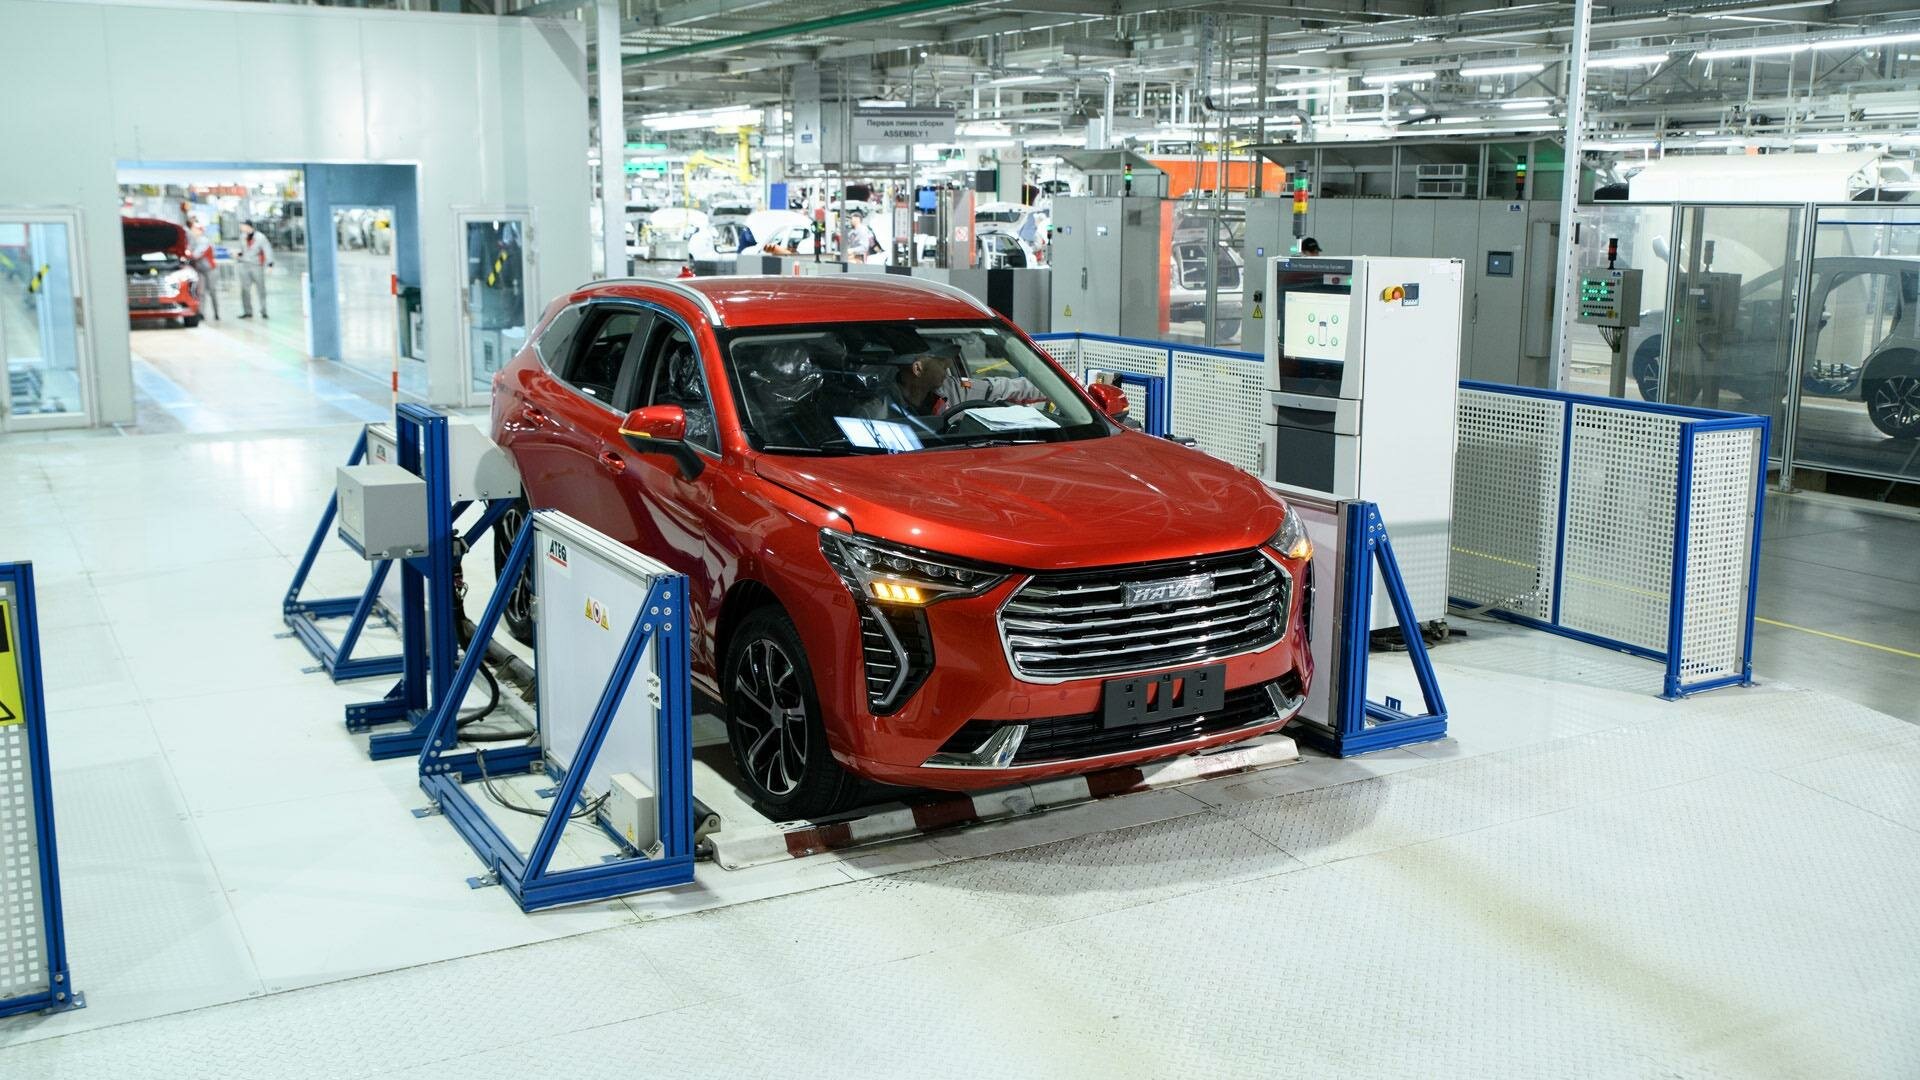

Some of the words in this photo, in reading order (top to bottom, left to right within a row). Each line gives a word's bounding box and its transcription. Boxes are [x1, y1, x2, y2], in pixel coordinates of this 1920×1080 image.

[867, 120, 894, 128] Первая
[920, 120, 944, 128] сборки
[549, 539, 567, 562] ATEQ
